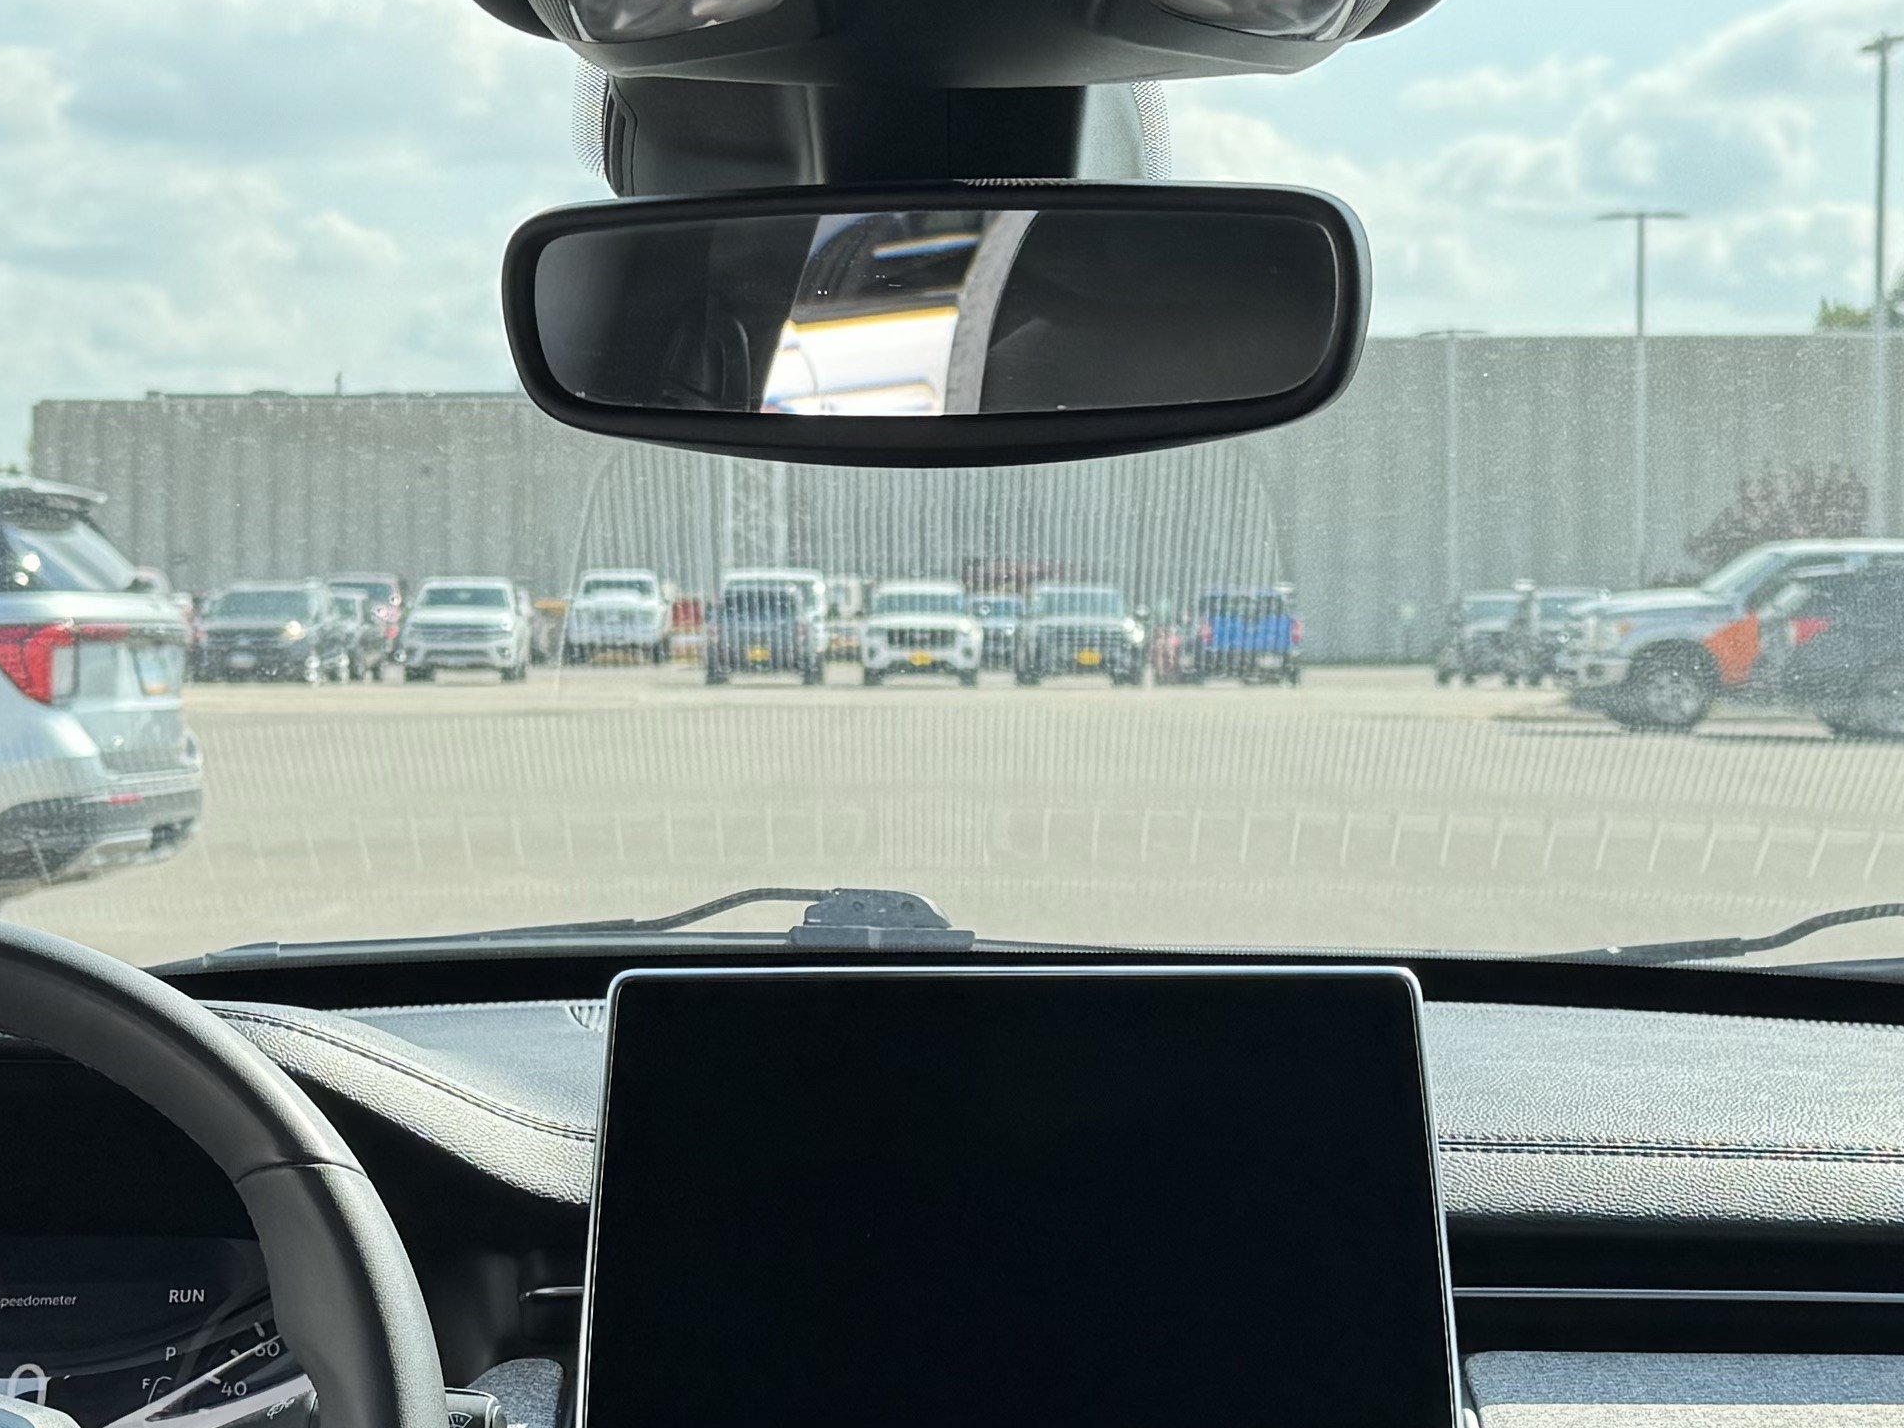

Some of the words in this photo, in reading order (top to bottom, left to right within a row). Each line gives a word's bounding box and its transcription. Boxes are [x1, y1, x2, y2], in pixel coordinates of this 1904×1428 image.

[168, 1289, 205, 1304] RUN
[165, 1347, 177, 1361] P
[221, 1382, 247, 1397] 40
